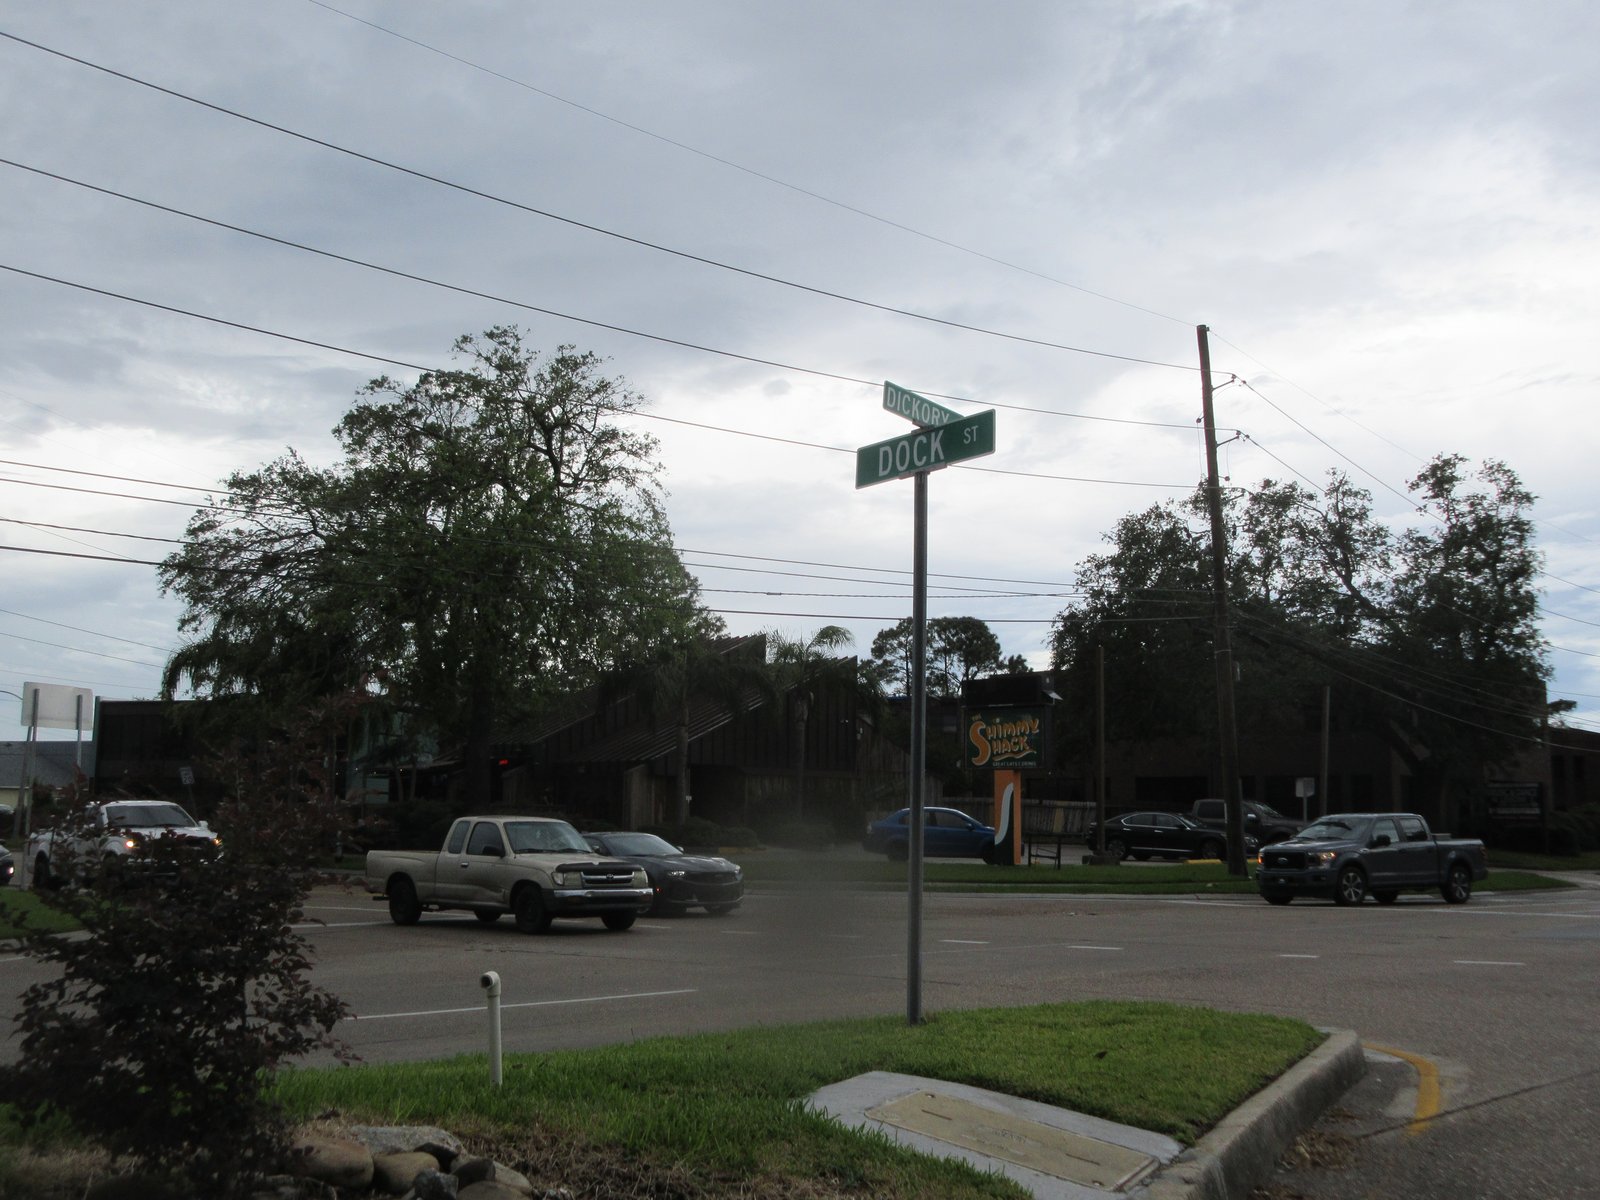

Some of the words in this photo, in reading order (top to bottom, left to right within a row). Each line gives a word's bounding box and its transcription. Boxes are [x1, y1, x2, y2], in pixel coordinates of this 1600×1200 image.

[887, 386, 950, 426] DICKORY
[878, 429, 945, 477] DOCK
[963, 425, 979, 445] ST
[969, 718, 1040, 766] SHIMMY
